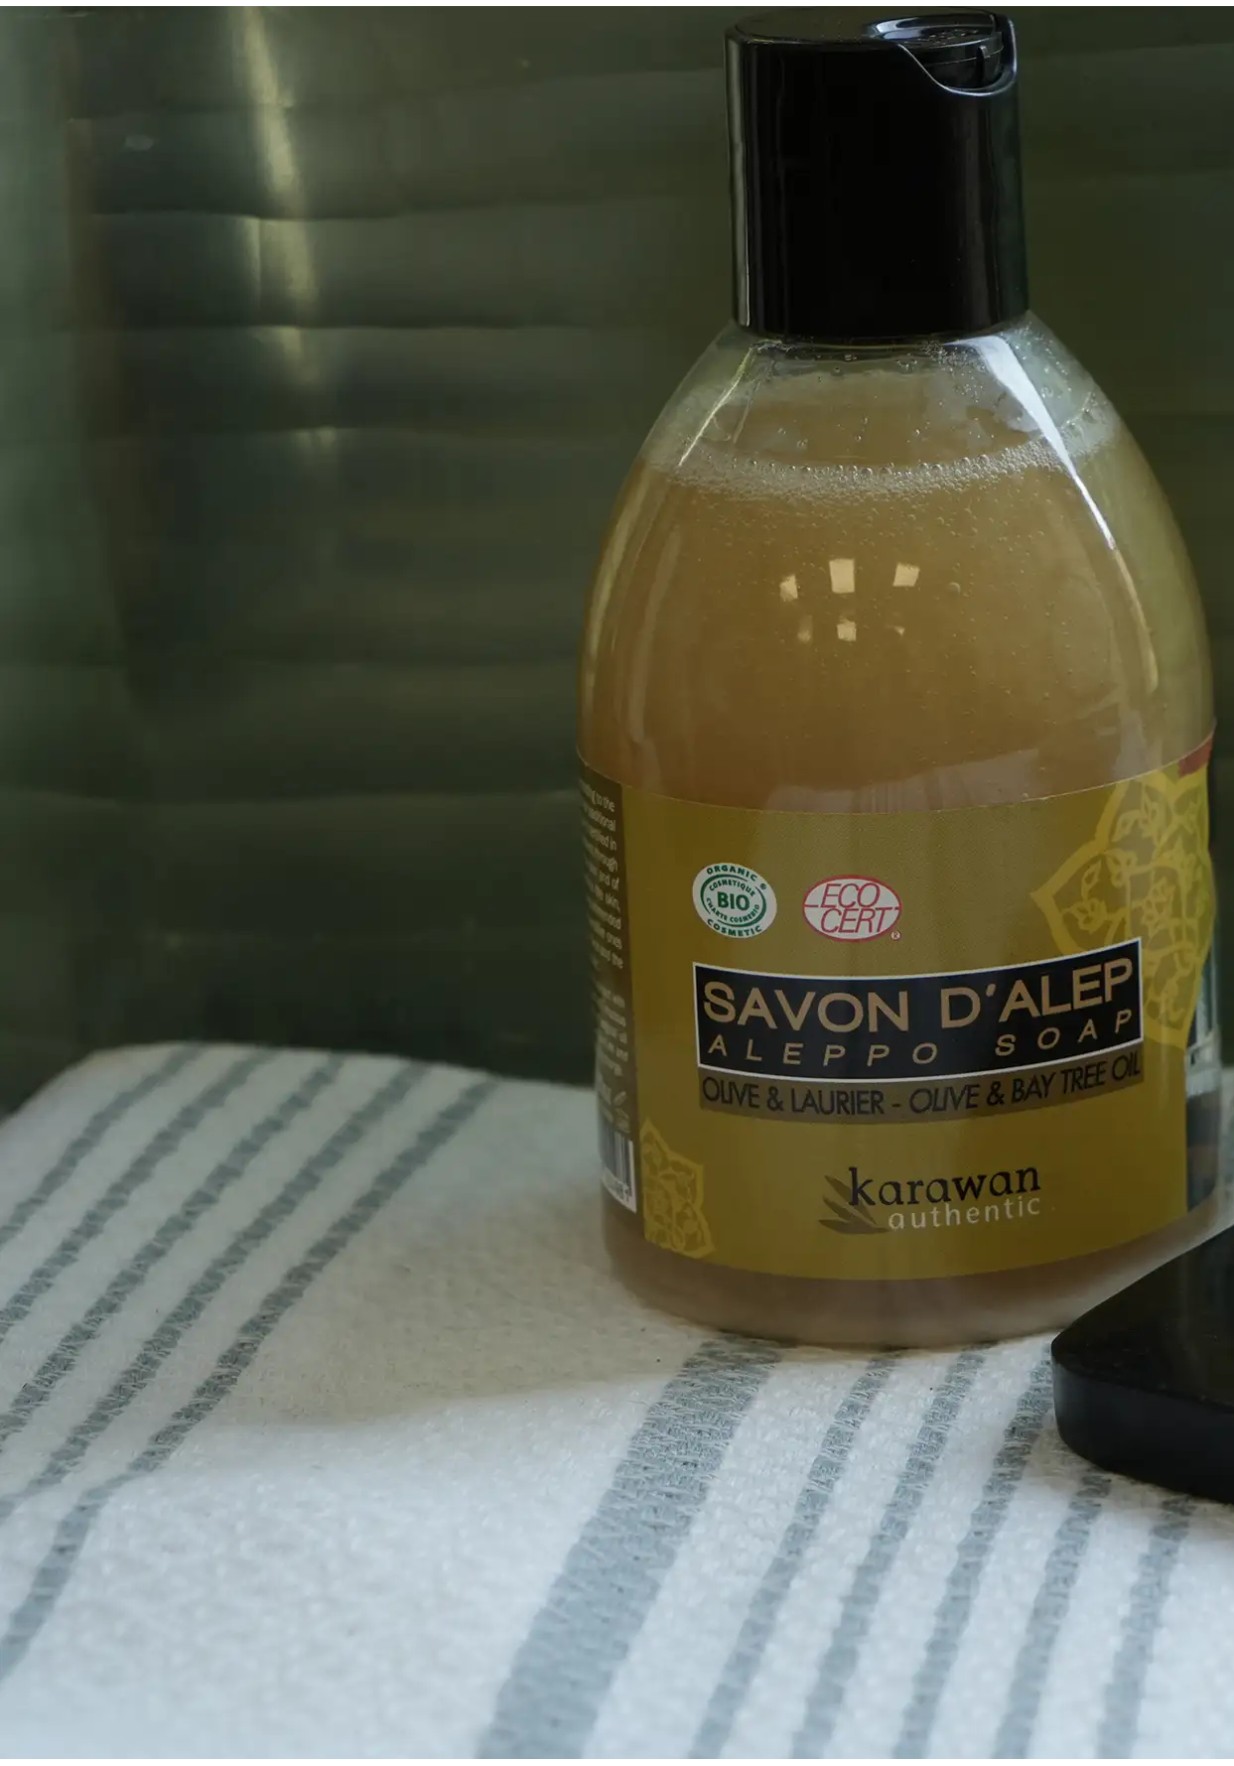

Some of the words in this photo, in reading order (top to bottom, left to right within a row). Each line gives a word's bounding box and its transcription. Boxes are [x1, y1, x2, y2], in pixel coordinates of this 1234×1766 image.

[706, 865, 758, 882] ORGANIC
[717, 891, 750, 911] BIO
[820, 883, 880, 908] ECO
[706, 898, 728, 921] CHARTE
[820, 907, 893, 933] CERT
[707, 919, 762, 937] COSMETIC
[703, 981, 909, 1033] SAVON
[940, 957, 1134, 1029] D'ALEP
[708, 1034, 938, 1067] ALEPPO
[994, 1008, 1133, 1057] SOAP
[702, 1076, 761, 1106] OLIVE
[766, 1086, 785, 1110] &
[791, 1088, 885, 1116] LAURIER
[909, 1083, 979, 1114] OLIVE
[985, 1080, 1006, 1106] &
[1012, 1073, 1057, 1101] BAY
[1058, 1061, 1108, 1094] TREE
[1112, 1051, 1142, 1083] OIL
[848, 1166, 1042, 1207] karawan
[888, 1196, 1042, 1231] authentic
